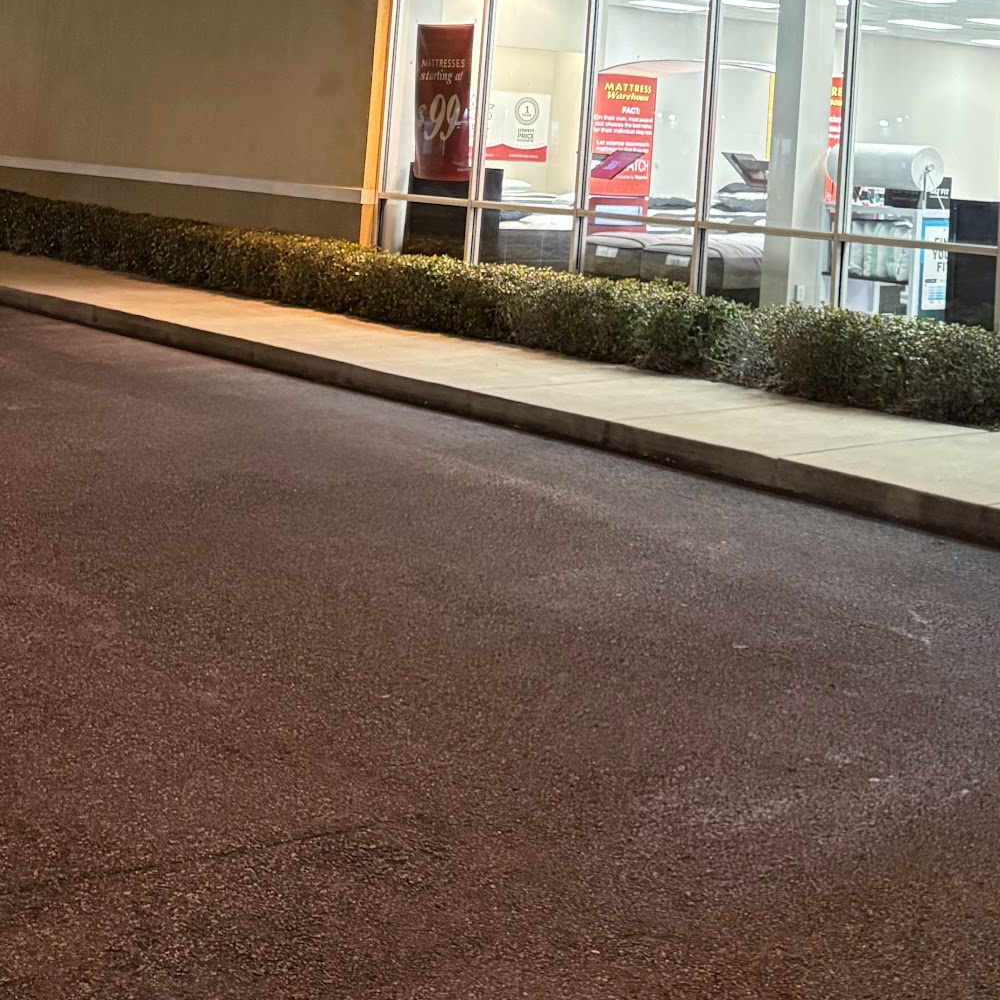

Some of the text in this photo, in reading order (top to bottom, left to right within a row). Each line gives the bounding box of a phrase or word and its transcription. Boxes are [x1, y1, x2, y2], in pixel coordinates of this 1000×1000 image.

[421, 58, 466, 68] MATTRESSES
[420, 69, 464, 85] starting at
[604, 82, 652, 94] MATTRESS
[517, 132, 535, 140] PRICE
